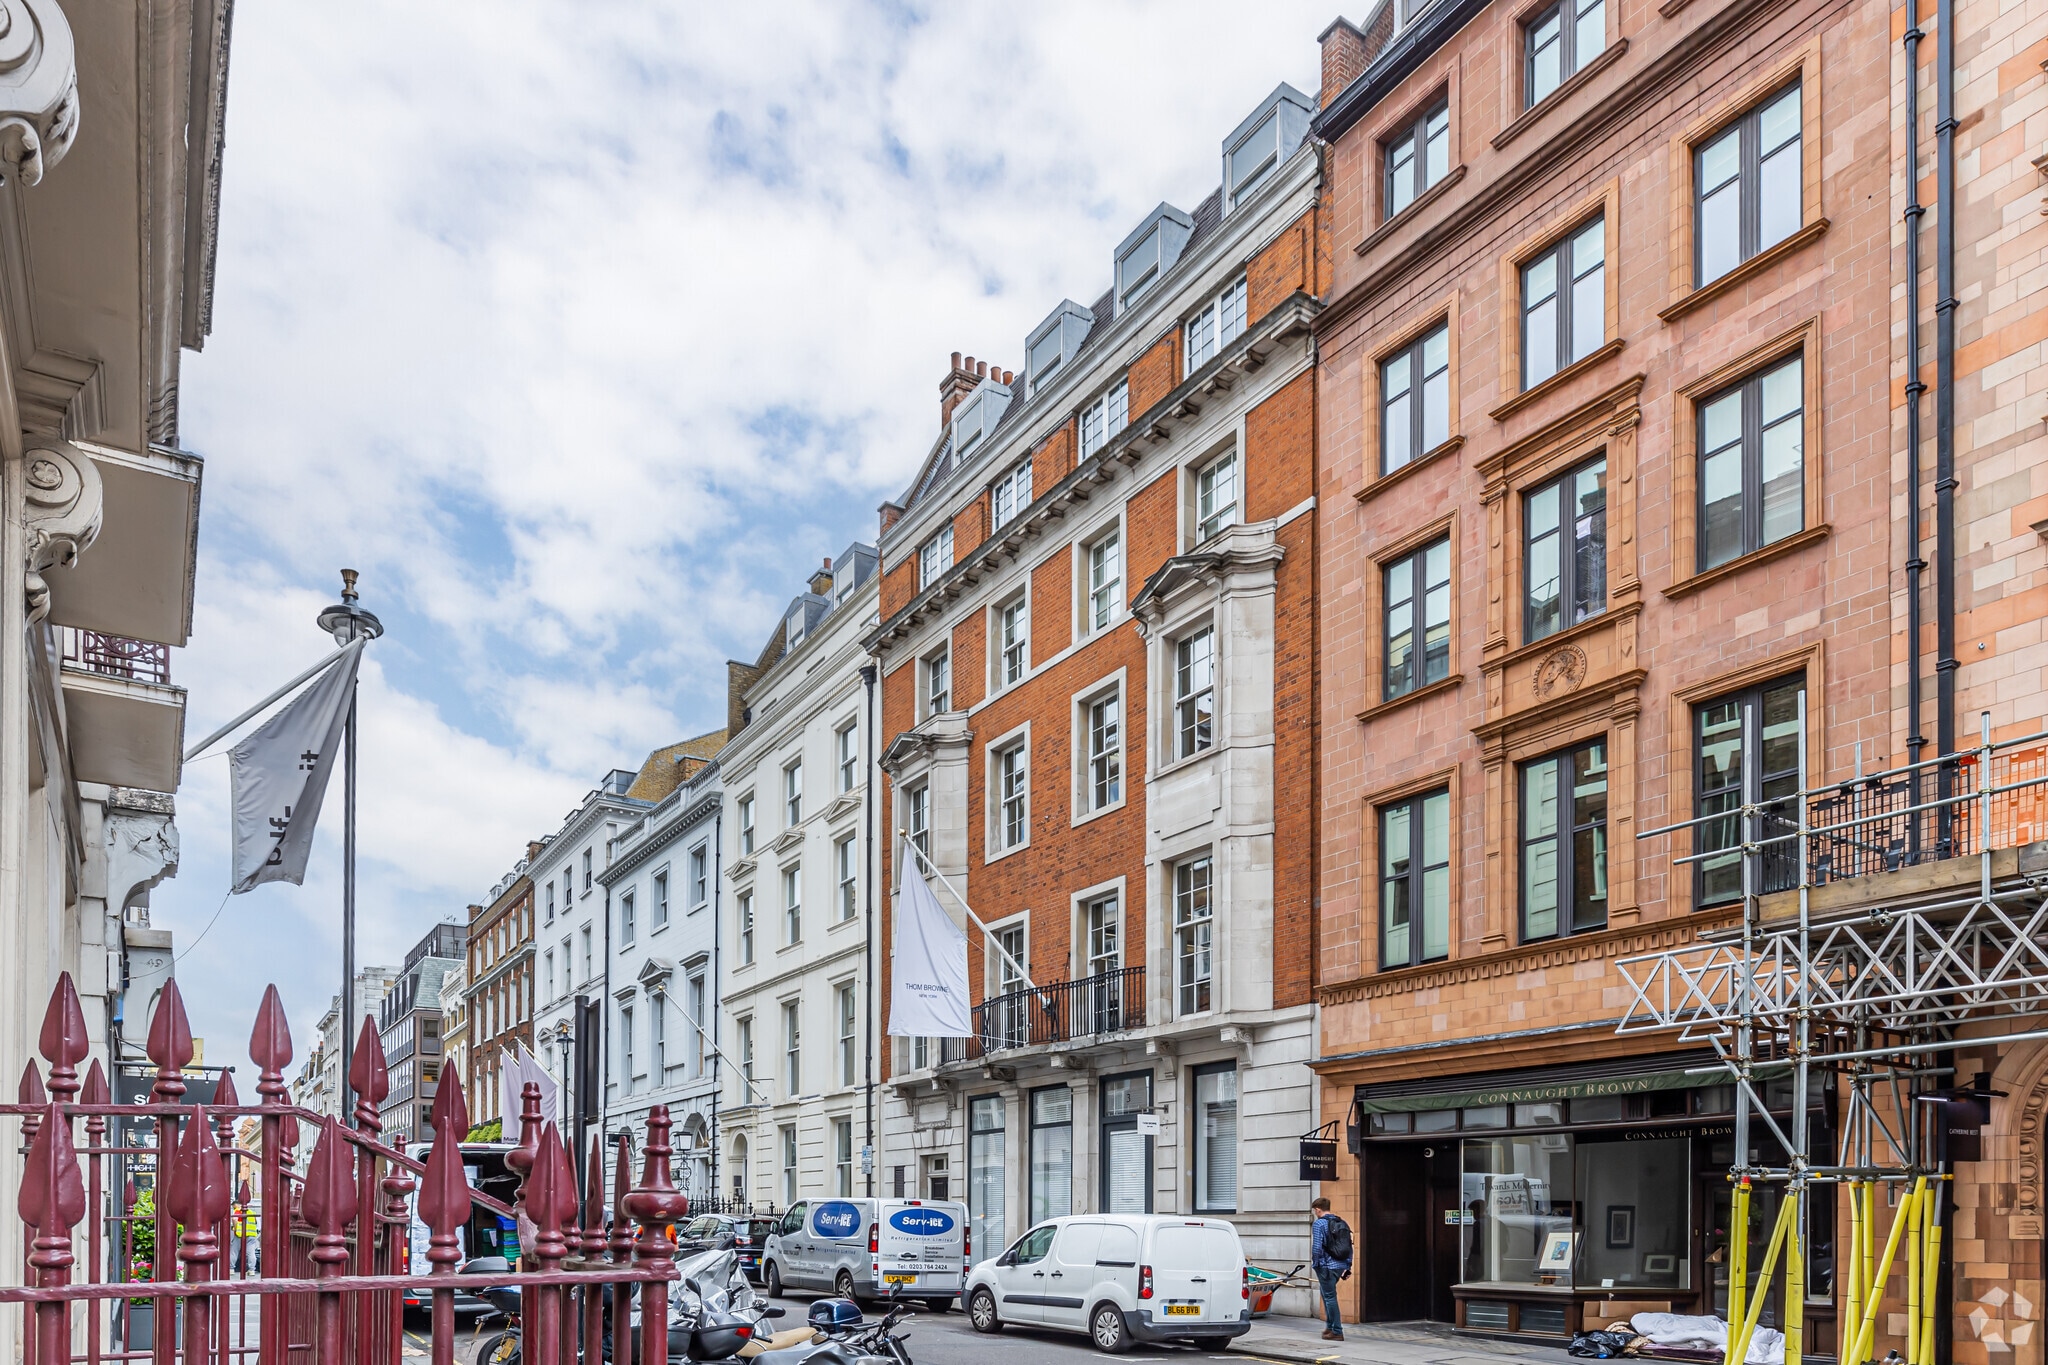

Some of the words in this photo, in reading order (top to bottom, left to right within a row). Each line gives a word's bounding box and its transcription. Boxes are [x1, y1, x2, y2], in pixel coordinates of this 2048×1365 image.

[905, 982, 922, 990] THOM
[1478, 1086, 1580, 1104] CONNAUGHT
[1586, 1080, 1649, 1096] BROWN
[1625, 1129, 1693, 1140] CONNAUGHT
[1701, 1127, 1732, 1136] BROW
[1480, 1181, 1510, 1191] Twards
[1168, 1306, 1184, 1314] BL66
